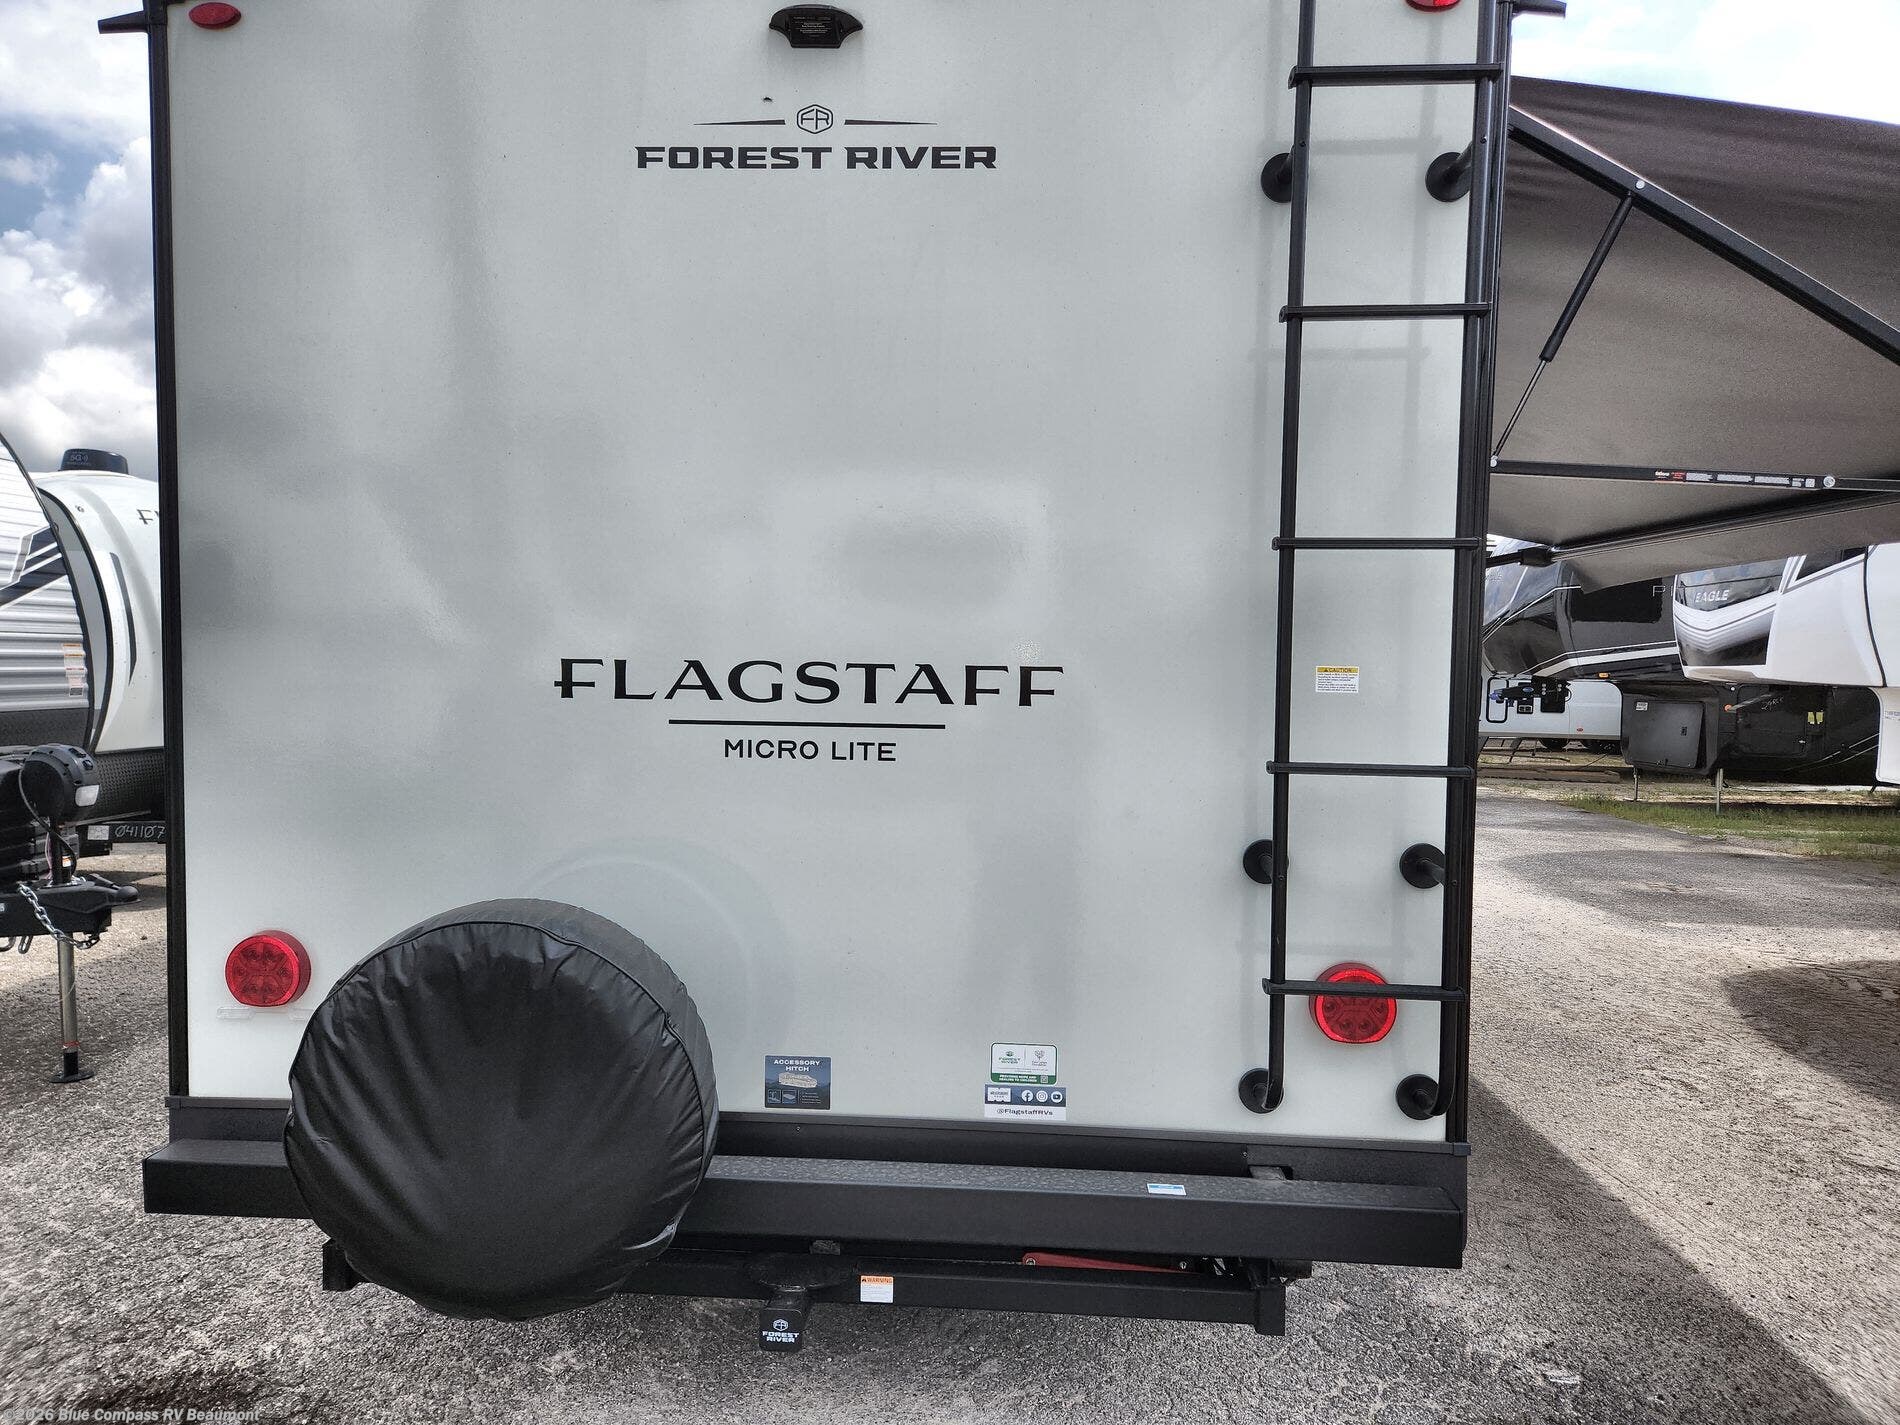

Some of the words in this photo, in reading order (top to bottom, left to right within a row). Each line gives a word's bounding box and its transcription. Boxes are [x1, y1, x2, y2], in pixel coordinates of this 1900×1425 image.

[635, 146, 832, 169] FOREST
[844, 146, 997, 170] RIVER
[1695, 589, 1730, 603] EAGLE
[554, 658, 1064, 707] FLAGSTAFF
[724, 739, 819, 760] MICRO
[832, 741, 897, 762] LITE
[997, 1108, 1053, 1116] @FlagstaffRVs
